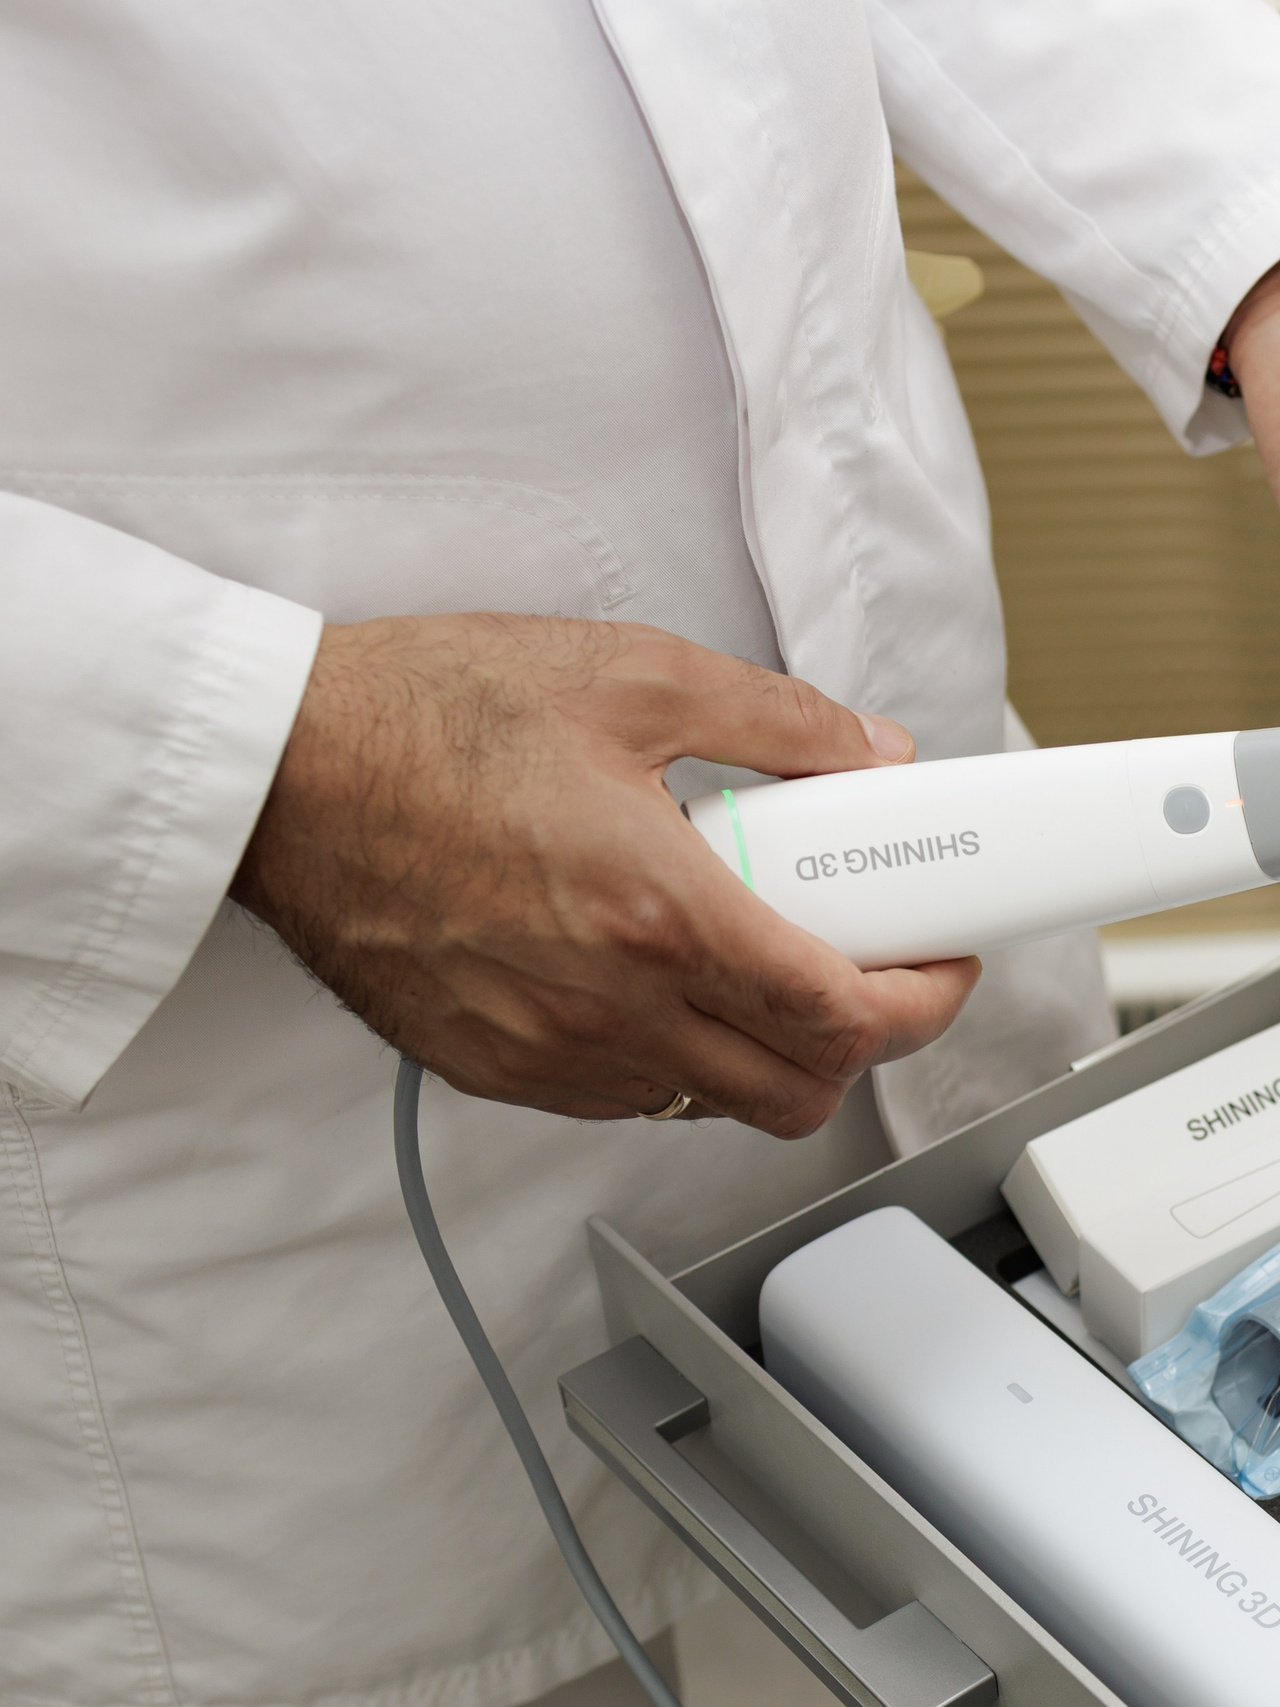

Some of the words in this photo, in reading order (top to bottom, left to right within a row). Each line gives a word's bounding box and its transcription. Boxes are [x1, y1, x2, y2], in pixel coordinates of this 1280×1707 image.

[795, 852, 838, 882] 3D
[843, 830, 980, 874] SHINING
[1127, 1493, 1249, 1598] SHINING
